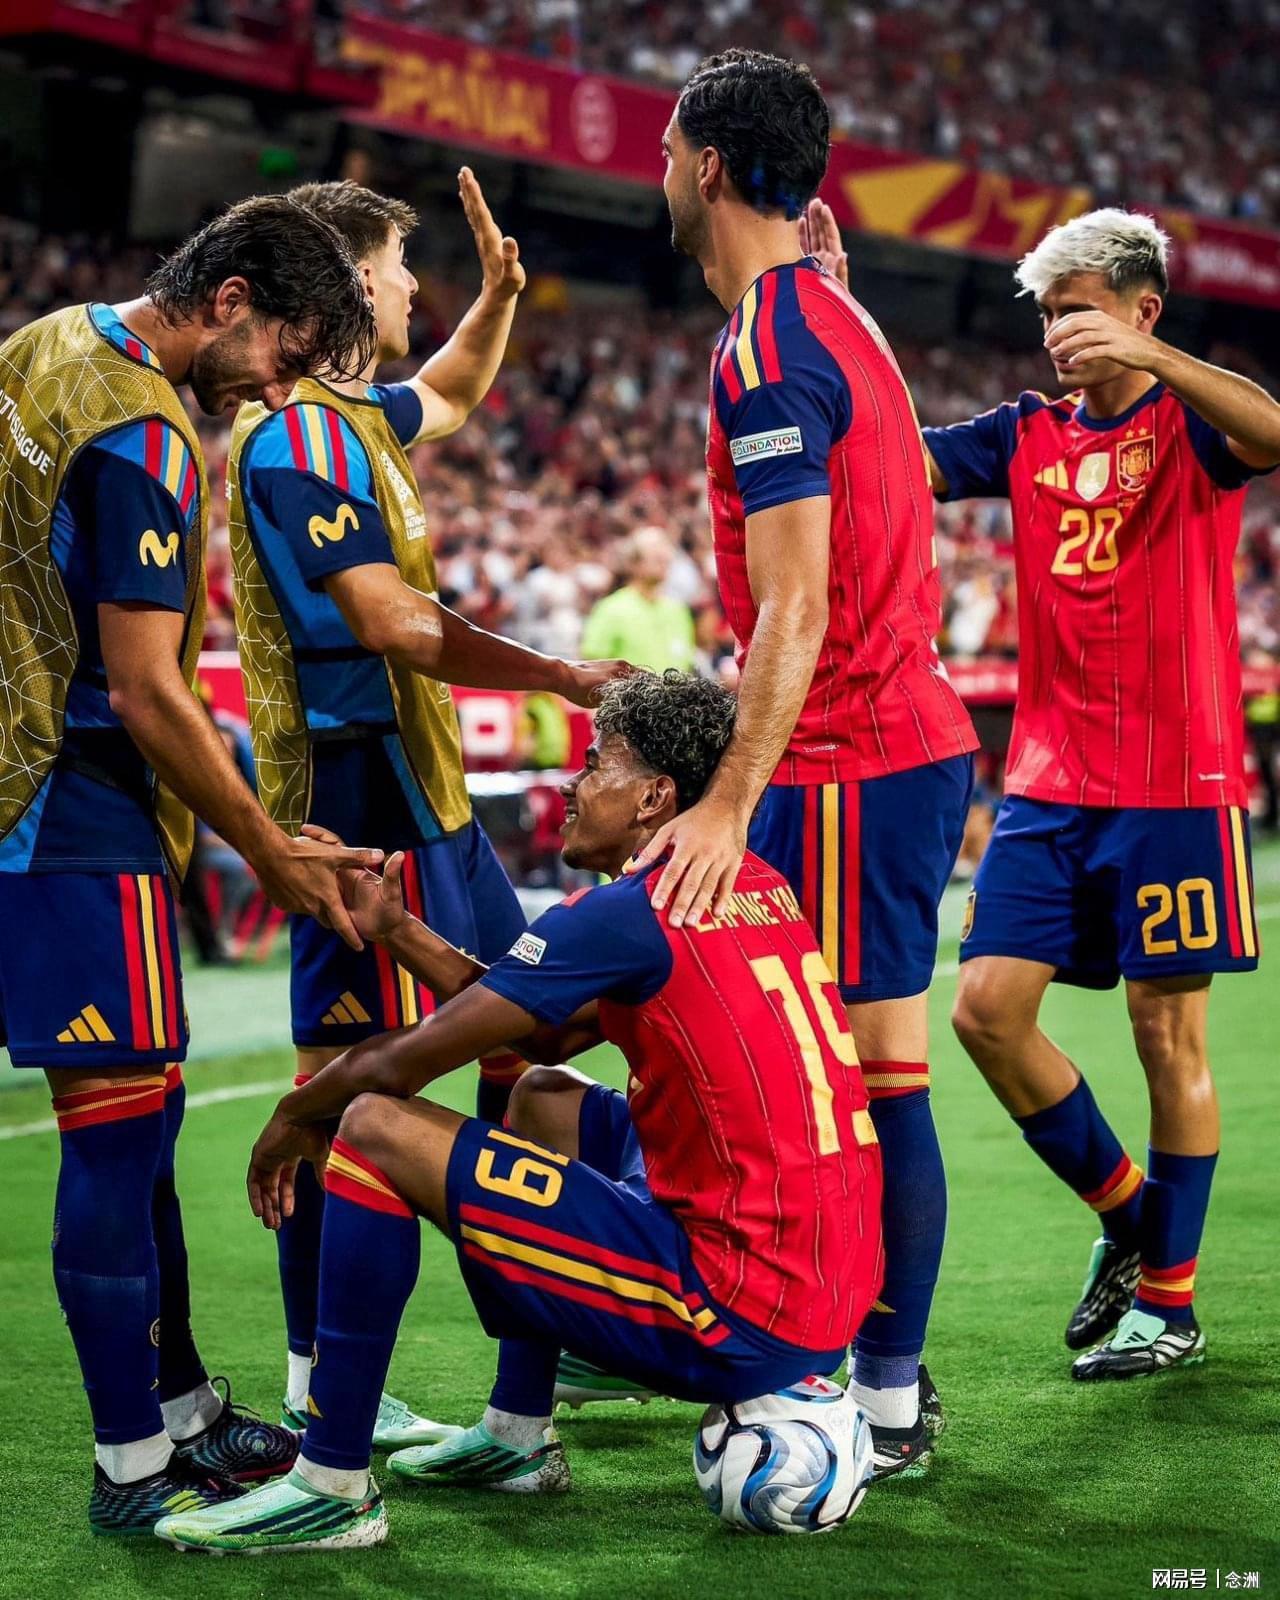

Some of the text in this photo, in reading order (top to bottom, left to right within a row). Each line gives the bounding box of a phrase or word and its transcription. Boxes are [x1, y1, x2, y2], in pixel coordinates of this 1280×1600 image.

[731, 434, 800, 456] FOUNDATION
[1051, 508, 1123, 575] 20
[1136, 877, 1218, 955] 20
